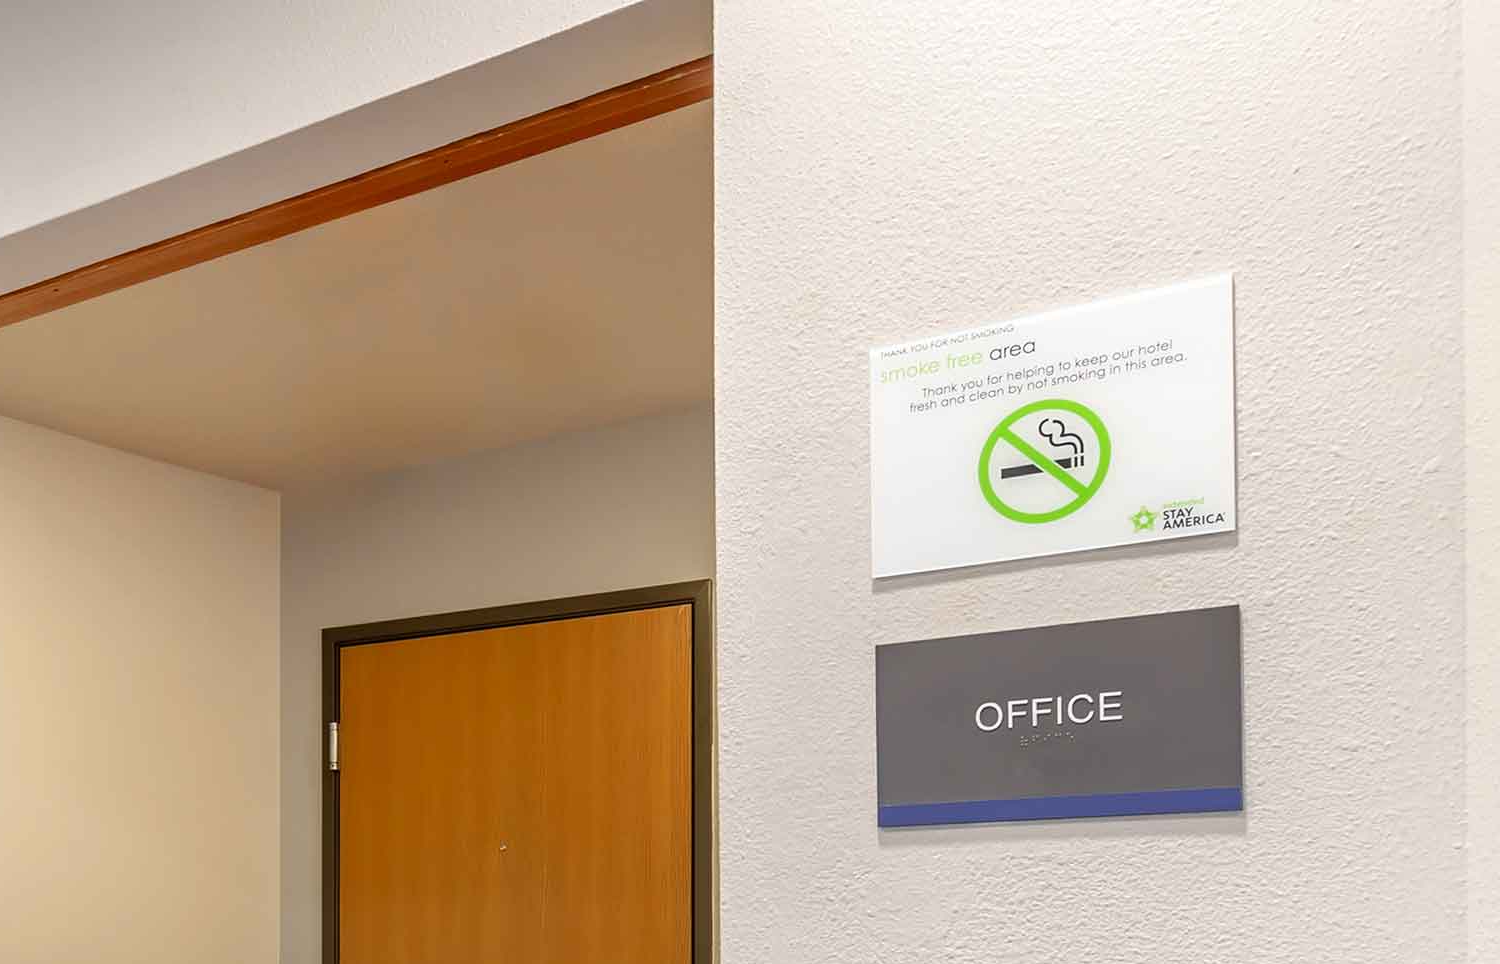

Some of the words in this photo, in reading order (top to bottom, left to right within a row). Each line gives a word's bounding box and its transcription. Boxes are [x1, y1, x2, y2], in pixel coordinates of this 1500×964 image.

[880, 359, 940, 384] smoke
[947, 352, 983, 368] free
[989, 339, 1036, 361] area
[881, 348, 908, 359] THANK
[910, 342, 928, 353] YOU
[930, 339, 948, 349] FOR
[949, 334, 967, 345] NOT
[971, 325, 1014, 340] SMOKING
[909, 399, 937, 413] fresh
[941, 393, 965, 408] and
[969, 387, 1005, 403] clean
[1008, 382, 1024, 396] by
[1027, 378, 1048, 391] not
[1052, 368, 1105, 387] smoking
[1110, 363, 1121, 375] in
[1125, 357, 1146, 371] this
[1150, 352, 1187, 367] area.
[922, 380, 958, 398] Thank
[960, 379, 983, 395] you
[987, 373, 1003, 386] for
[1007, 364, 1054, 382] helping
[1059, 361, 1071, 372] to
[1075, 354, 1108, 370] keep
[1112, 350, 1134, 362] our
[1138, 340, 1173, 357] hotel
[1163, 507, 1193, 520] STAY
[1163, 513, 1225, 529] AMERICA
[974, 690, 1123, 732] OFFICE
